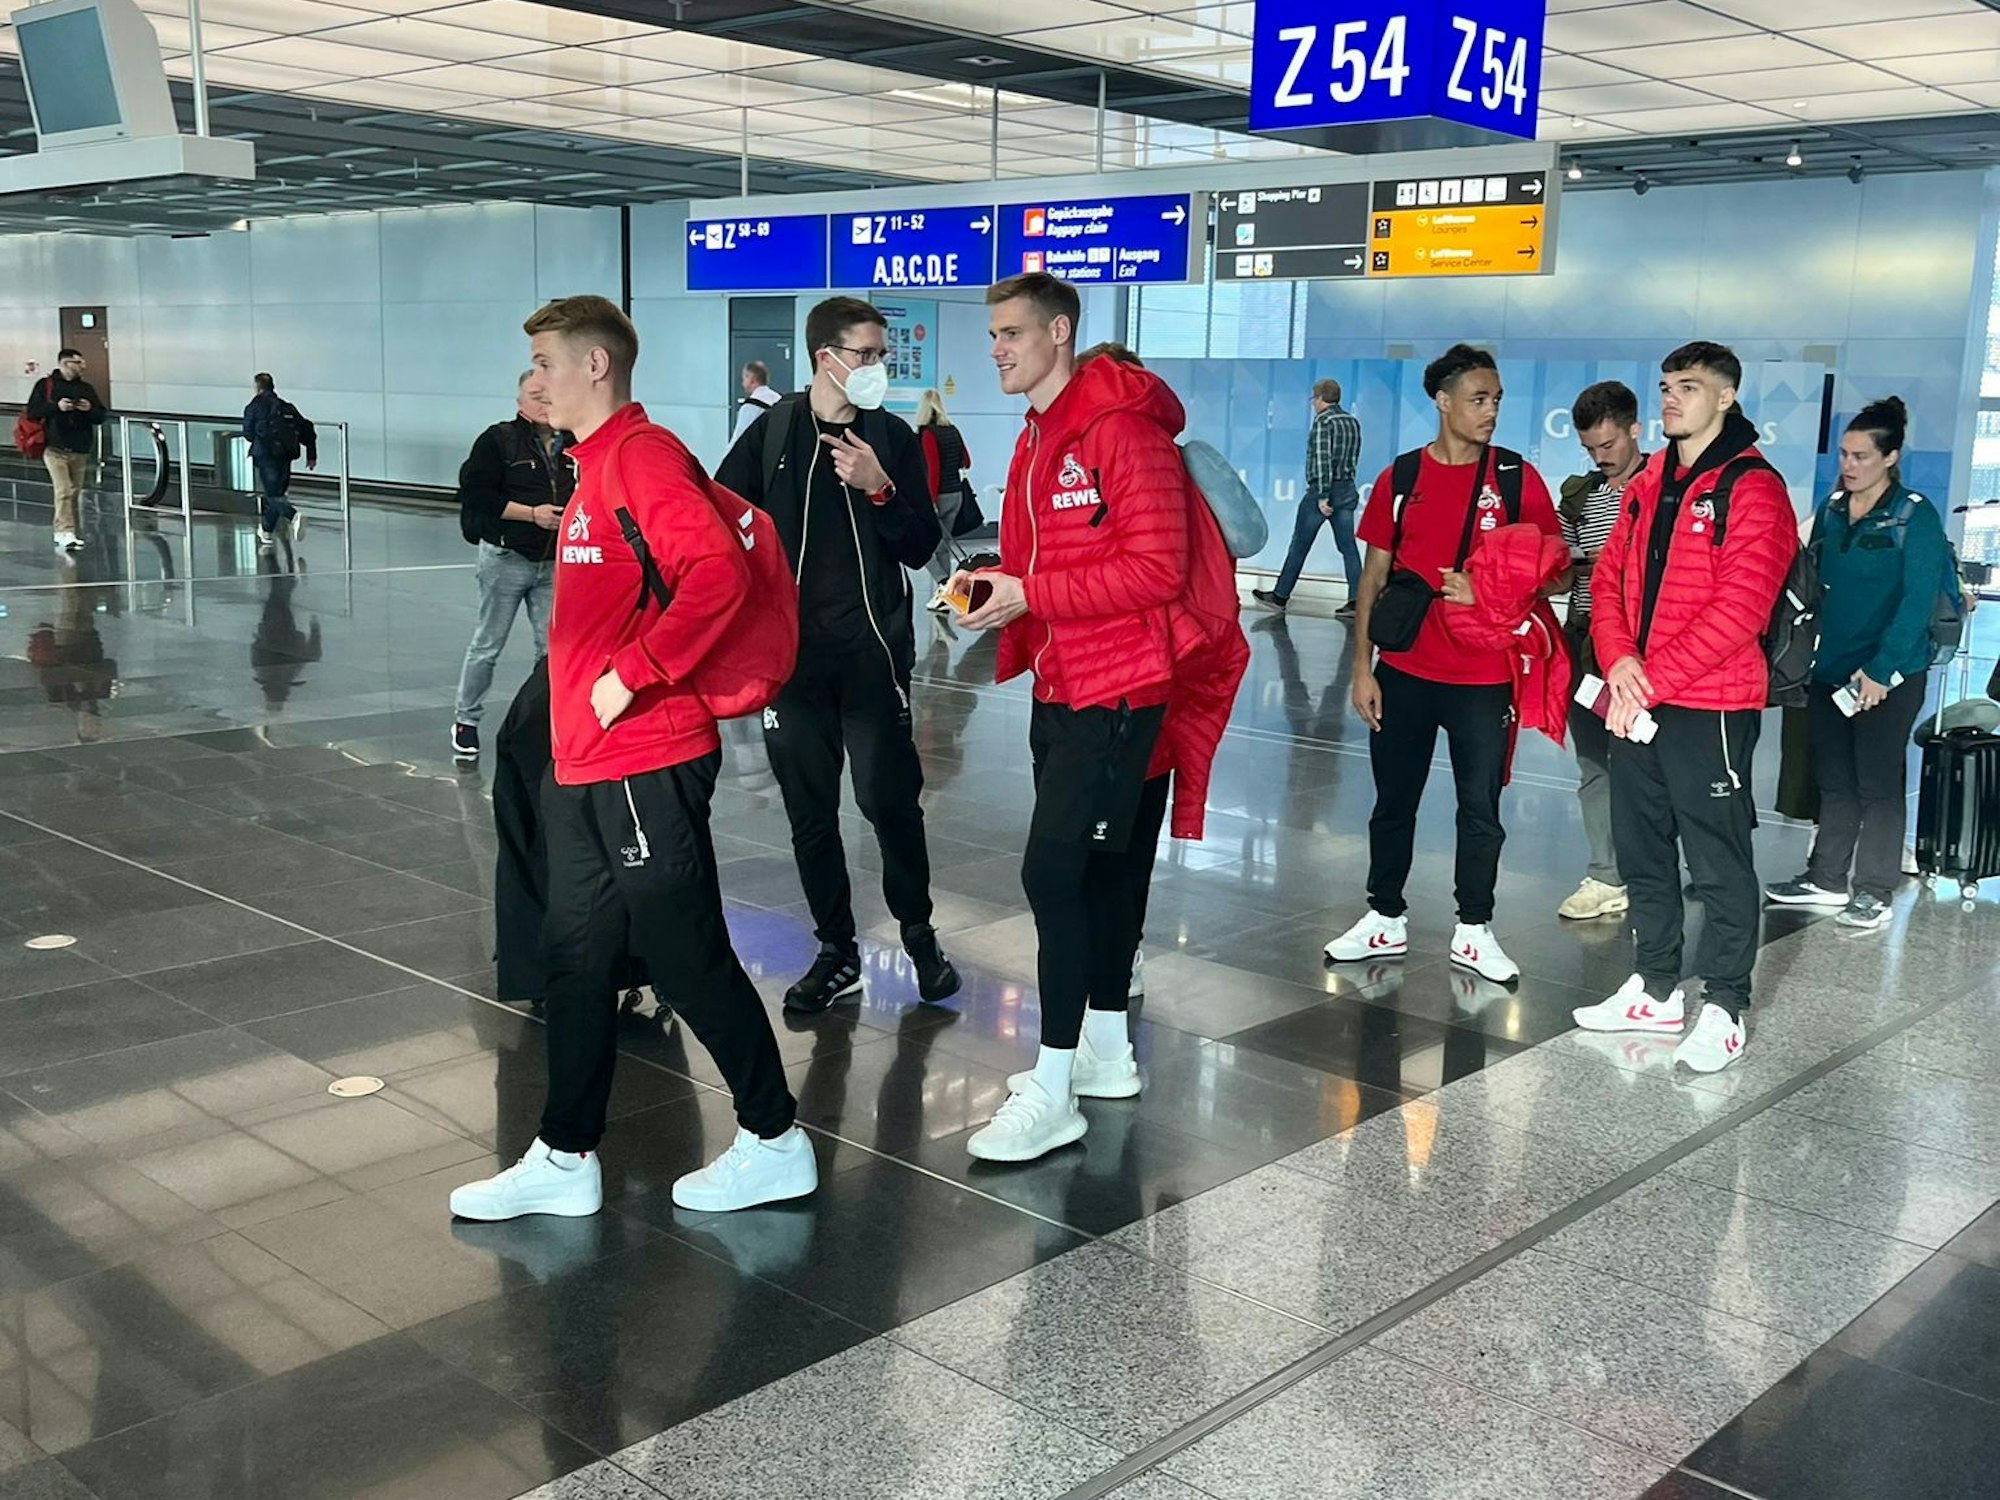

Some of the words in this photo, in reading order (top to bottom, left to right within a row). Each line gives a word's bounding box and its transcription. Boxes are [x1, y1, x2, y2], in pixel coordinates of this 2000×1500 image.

[1274, 25, 1317, 108] Z
[1329, 15, 1410, 103] 54
[1447, 15, 1477, 103] Z
[1480, 28, 1527, 116] 54
[724, 223, 736, 249] Z
[873, 216, 887, 244] Z
[1119, 247, 1160, 264] Ausgang
[1119, 264, 1138, 278] Exit
[1051, 488, 1102, 511] REWE
